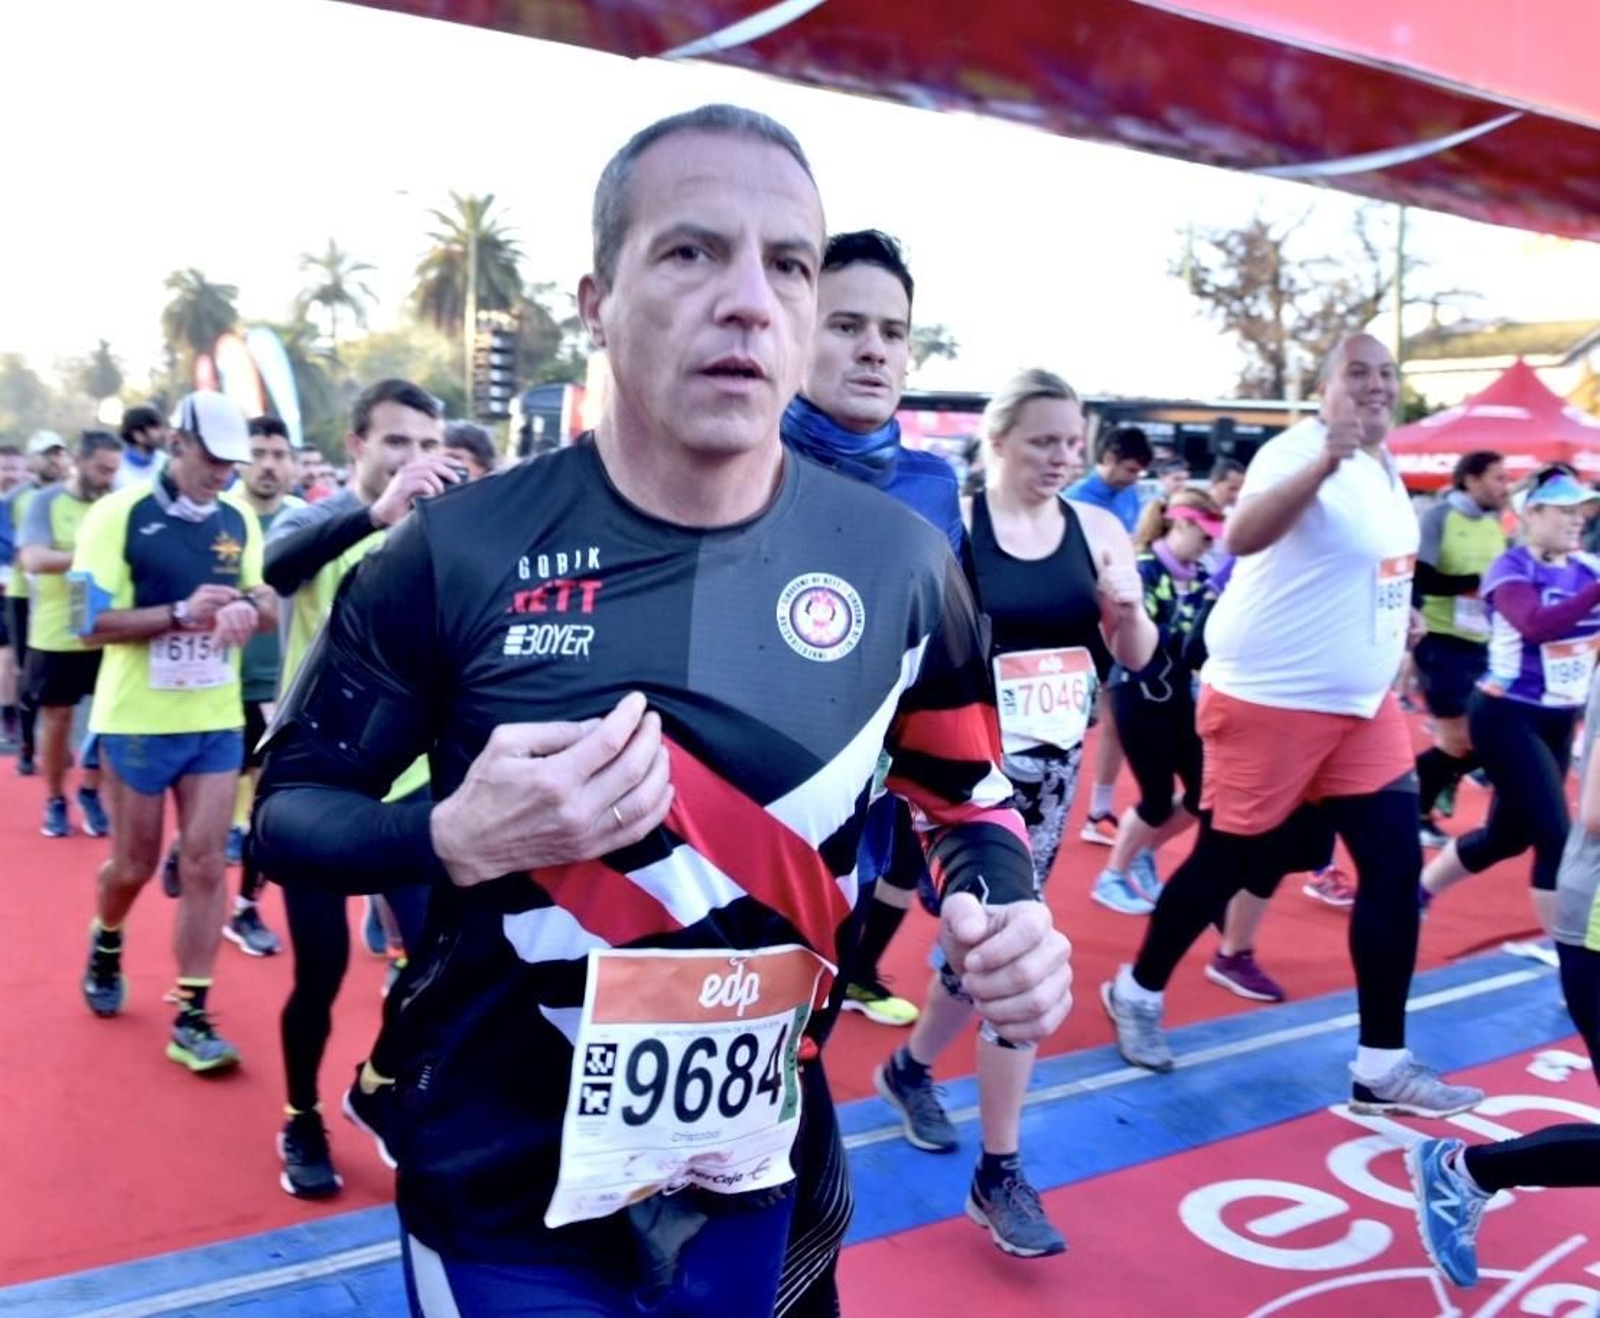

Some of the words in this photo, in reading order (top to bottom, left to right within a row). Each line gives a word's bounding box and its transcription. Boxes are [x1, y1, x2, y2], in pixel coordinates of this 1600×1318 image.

[167, 635, 220, 661] 615
[1018, 679, 1088, 716] 7046
[698, 957, 761, 1017] edp
[620, 1022, 789, 1127] 9684
